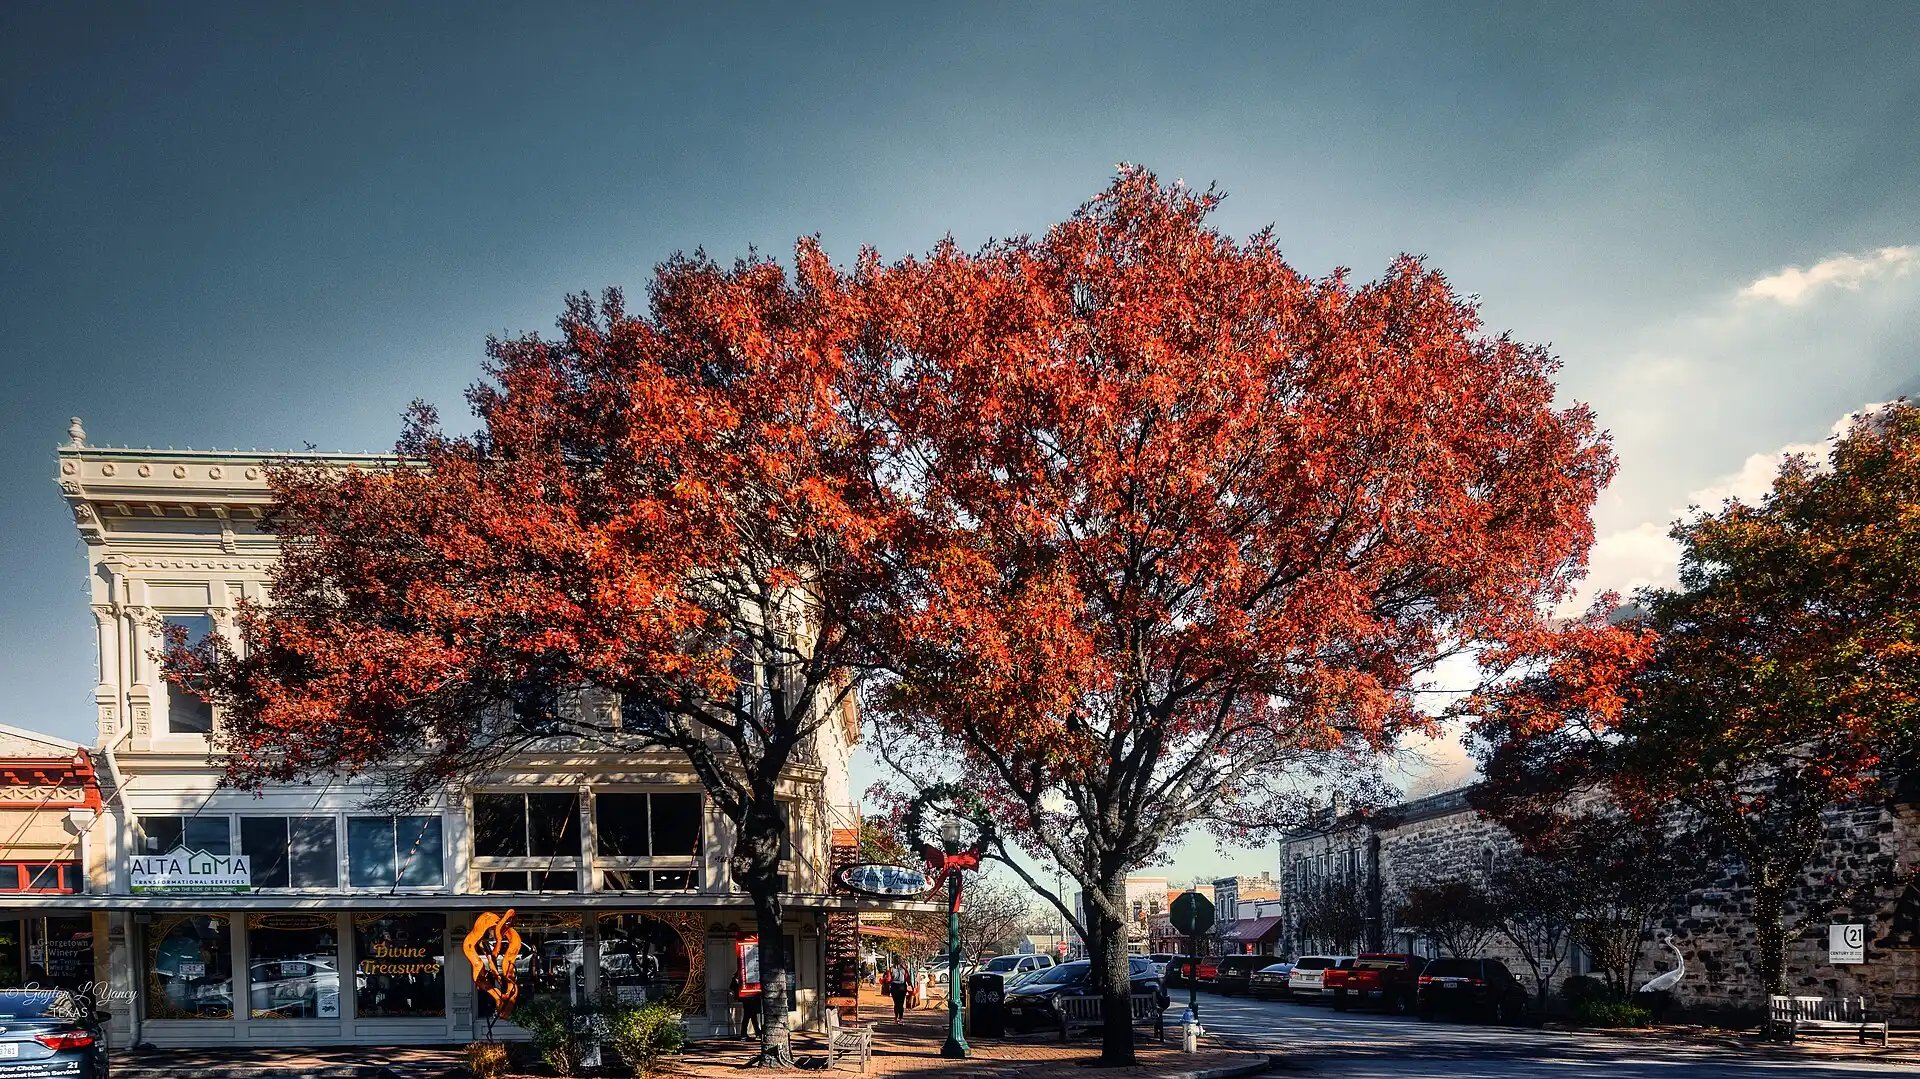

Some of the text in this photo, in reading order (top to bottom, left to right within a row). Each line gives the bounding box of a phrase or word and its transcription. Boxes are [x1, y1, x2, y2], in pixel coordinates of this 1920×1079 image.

[131, 857, 247, 875] ALTA LOMA
[880, 869, 926, 887] Treasures
[48, 948, 79, 957] Winery
[373, 943, 426, 958] Divine
[360, 960, 441, 975] Treasures
